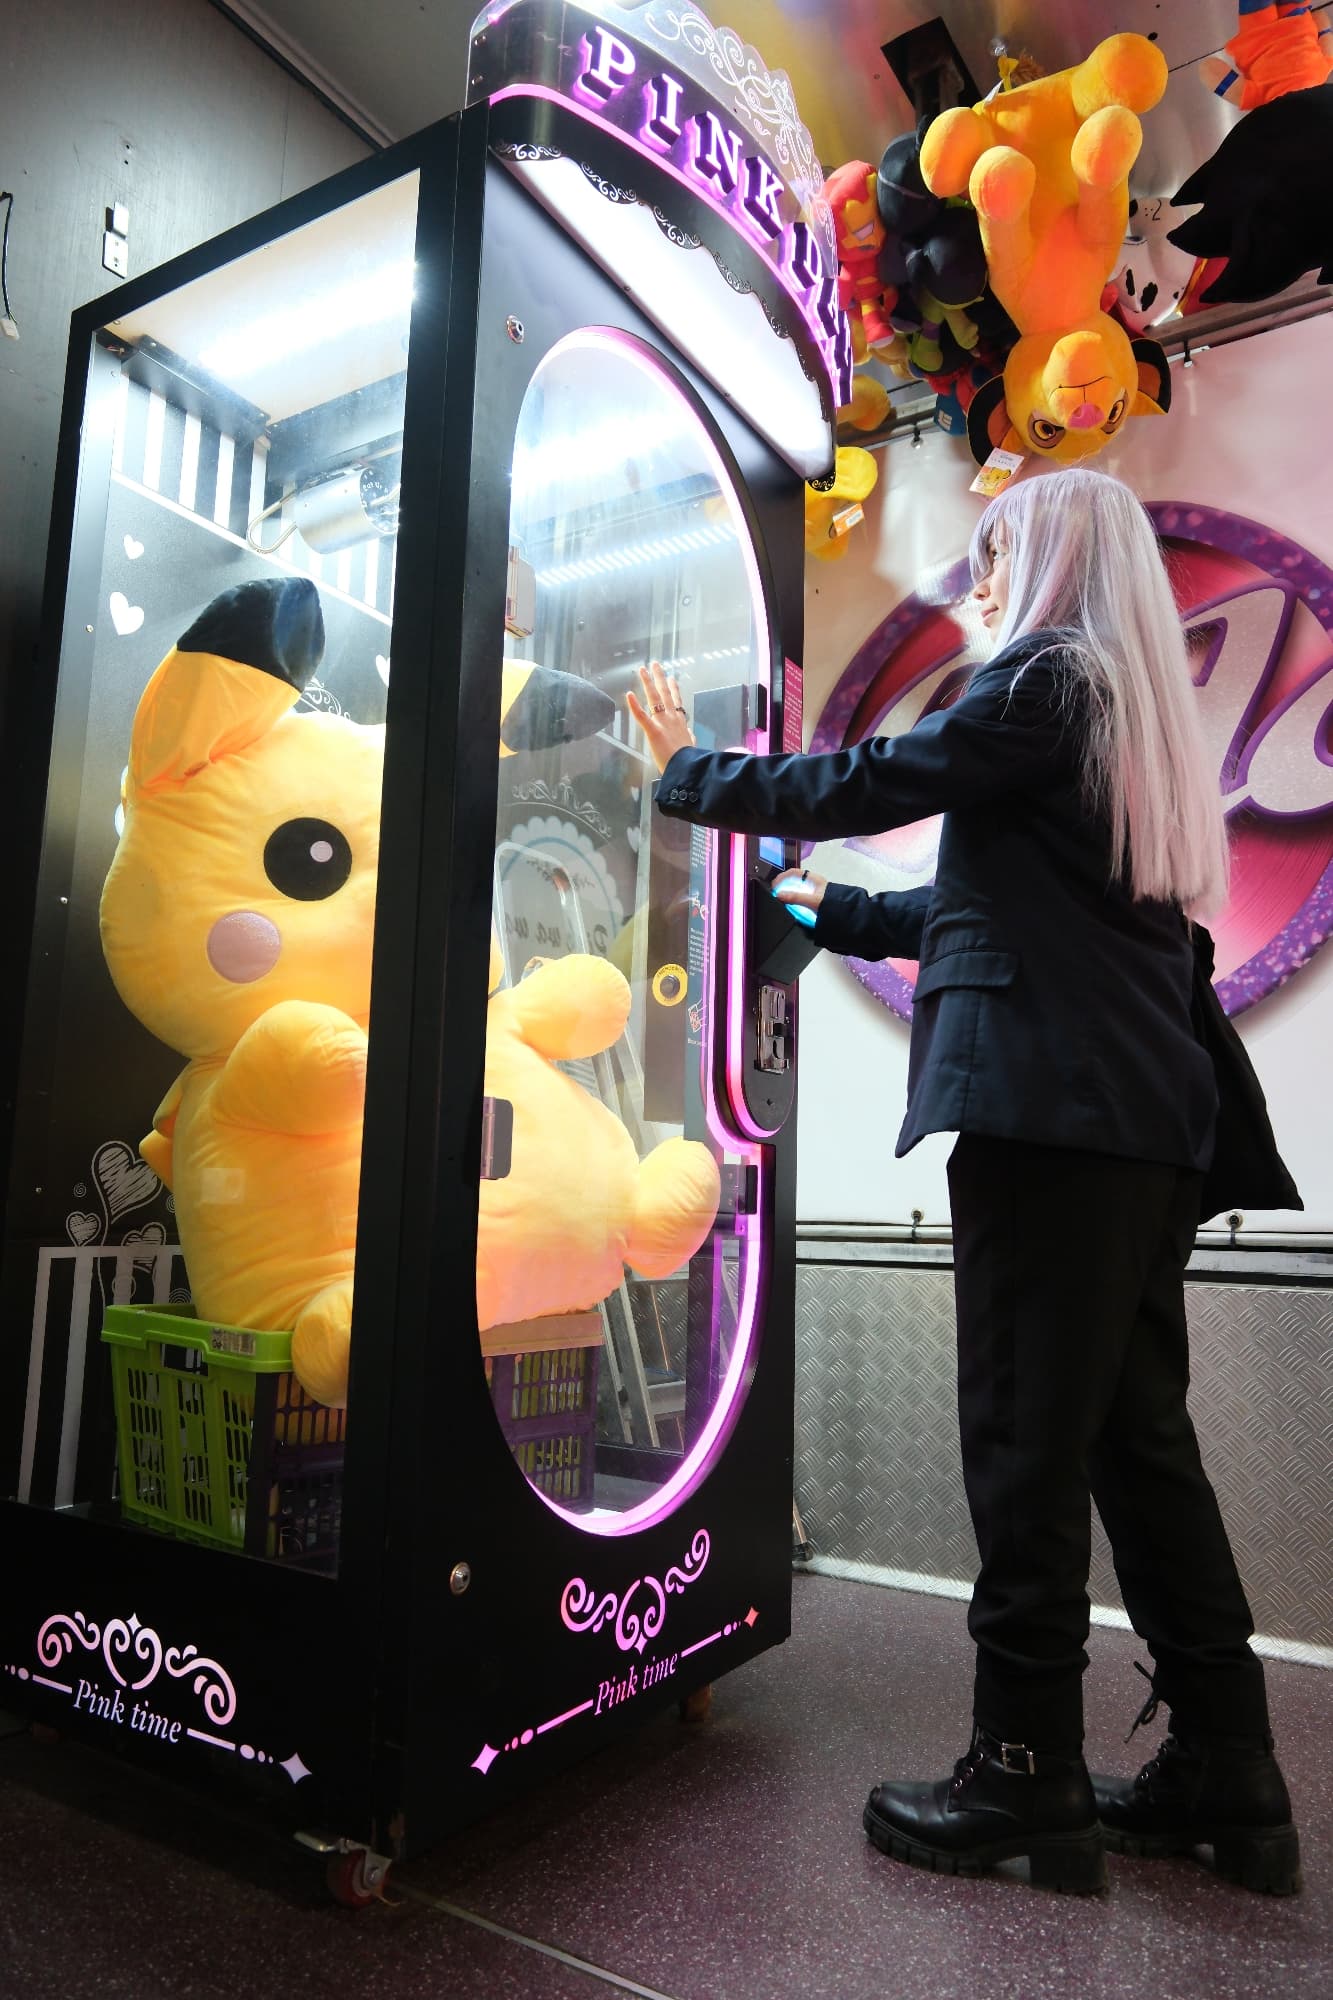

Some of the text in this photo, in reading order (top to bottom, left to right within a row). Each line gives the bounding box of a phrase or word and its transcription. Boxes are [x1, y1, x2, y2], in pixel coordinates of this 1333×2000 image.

[576, 26, 784, 242] PINK
[73, 1679, 182, 1743] Pink time
[594, 1652, 678, 1716] Pink time
